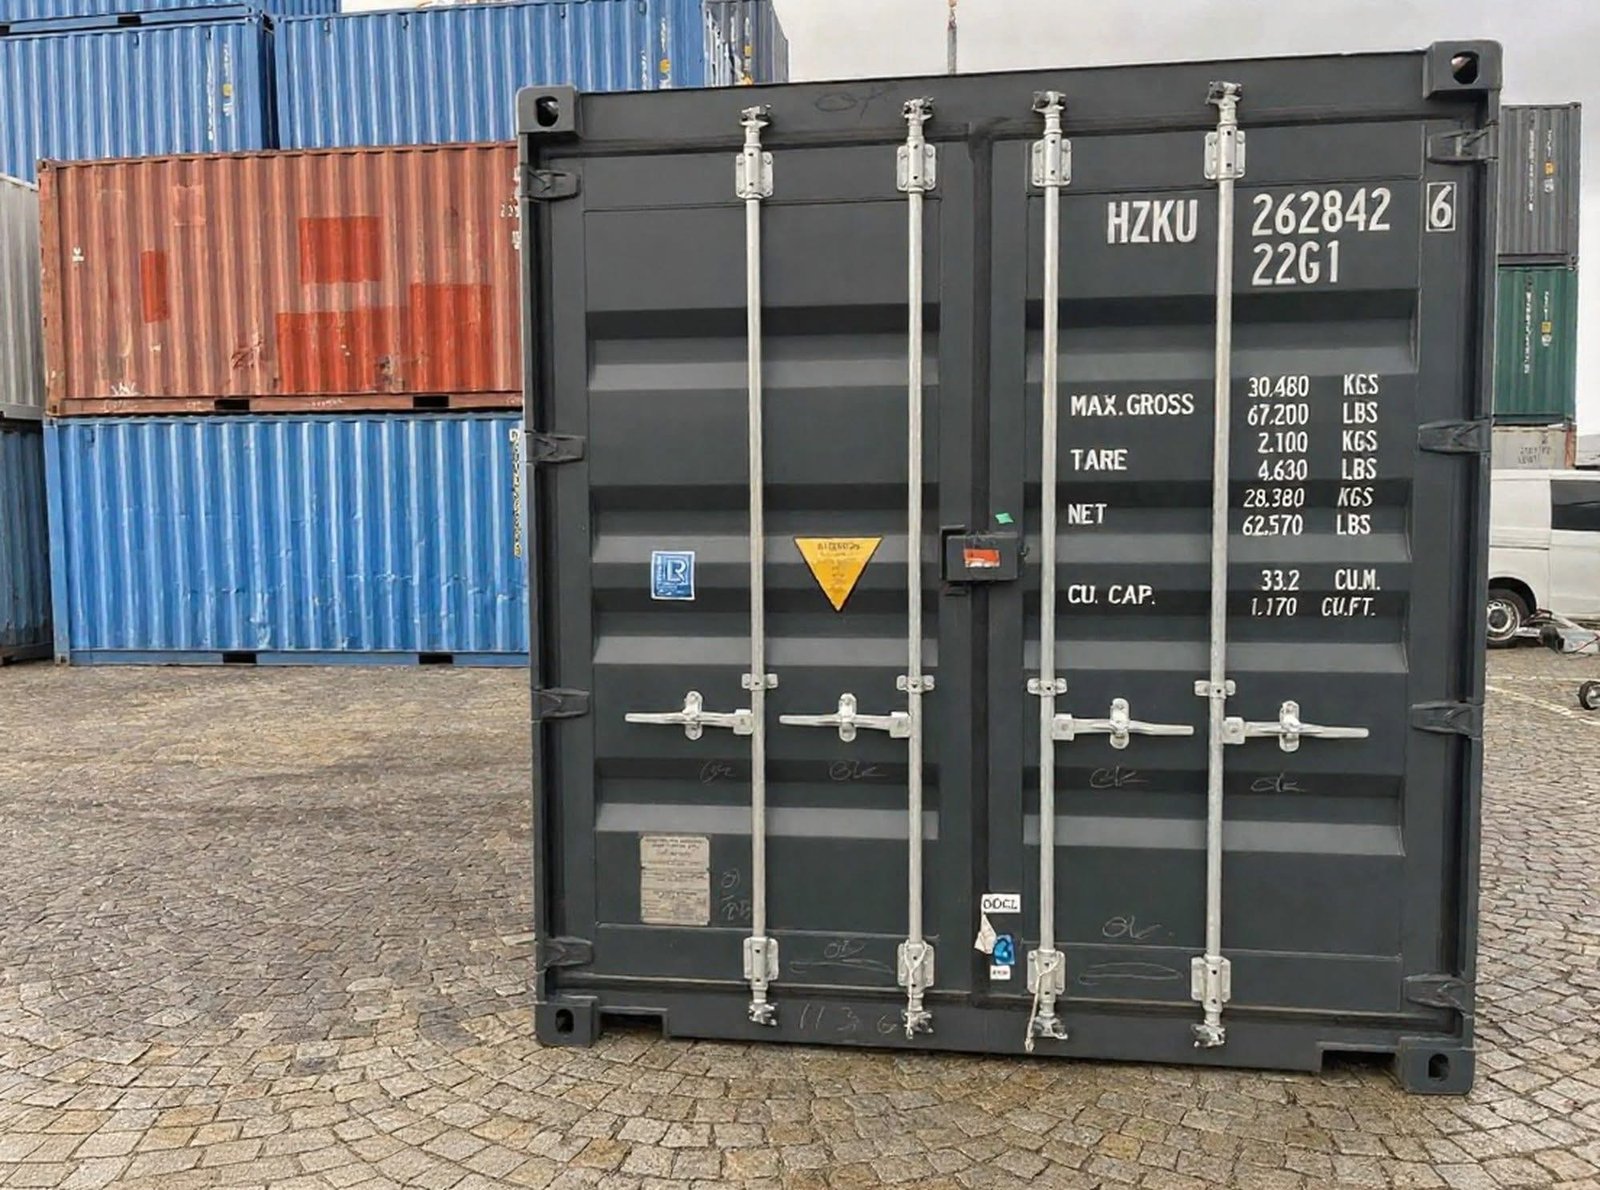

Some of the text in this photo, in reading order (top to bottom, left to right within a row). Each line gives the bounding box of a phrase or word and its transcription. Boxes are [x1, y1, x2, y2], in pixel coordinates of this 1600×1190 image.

[1107, 185, 1452, 244] HZKU 262842 6
[1252, 240, 1338, 286] 22G1
[1343, 374, 1379, 396] KGS
[1343, 401, 1378, 424] LBS
[1342, 429, 1378, 452] KGS
[1070, 448, 1128, 470] TARE
[1341, 457, 1377, 480] LBS
[1337, 486, 1374, 507] KGS
[1067, 503, 1107, 524] NET
[1336, 513, 1371, 535] LBS
[1261, 569, 1300, 591] 33.2
[1067, 584, 1155, 605] CU. CAP.
